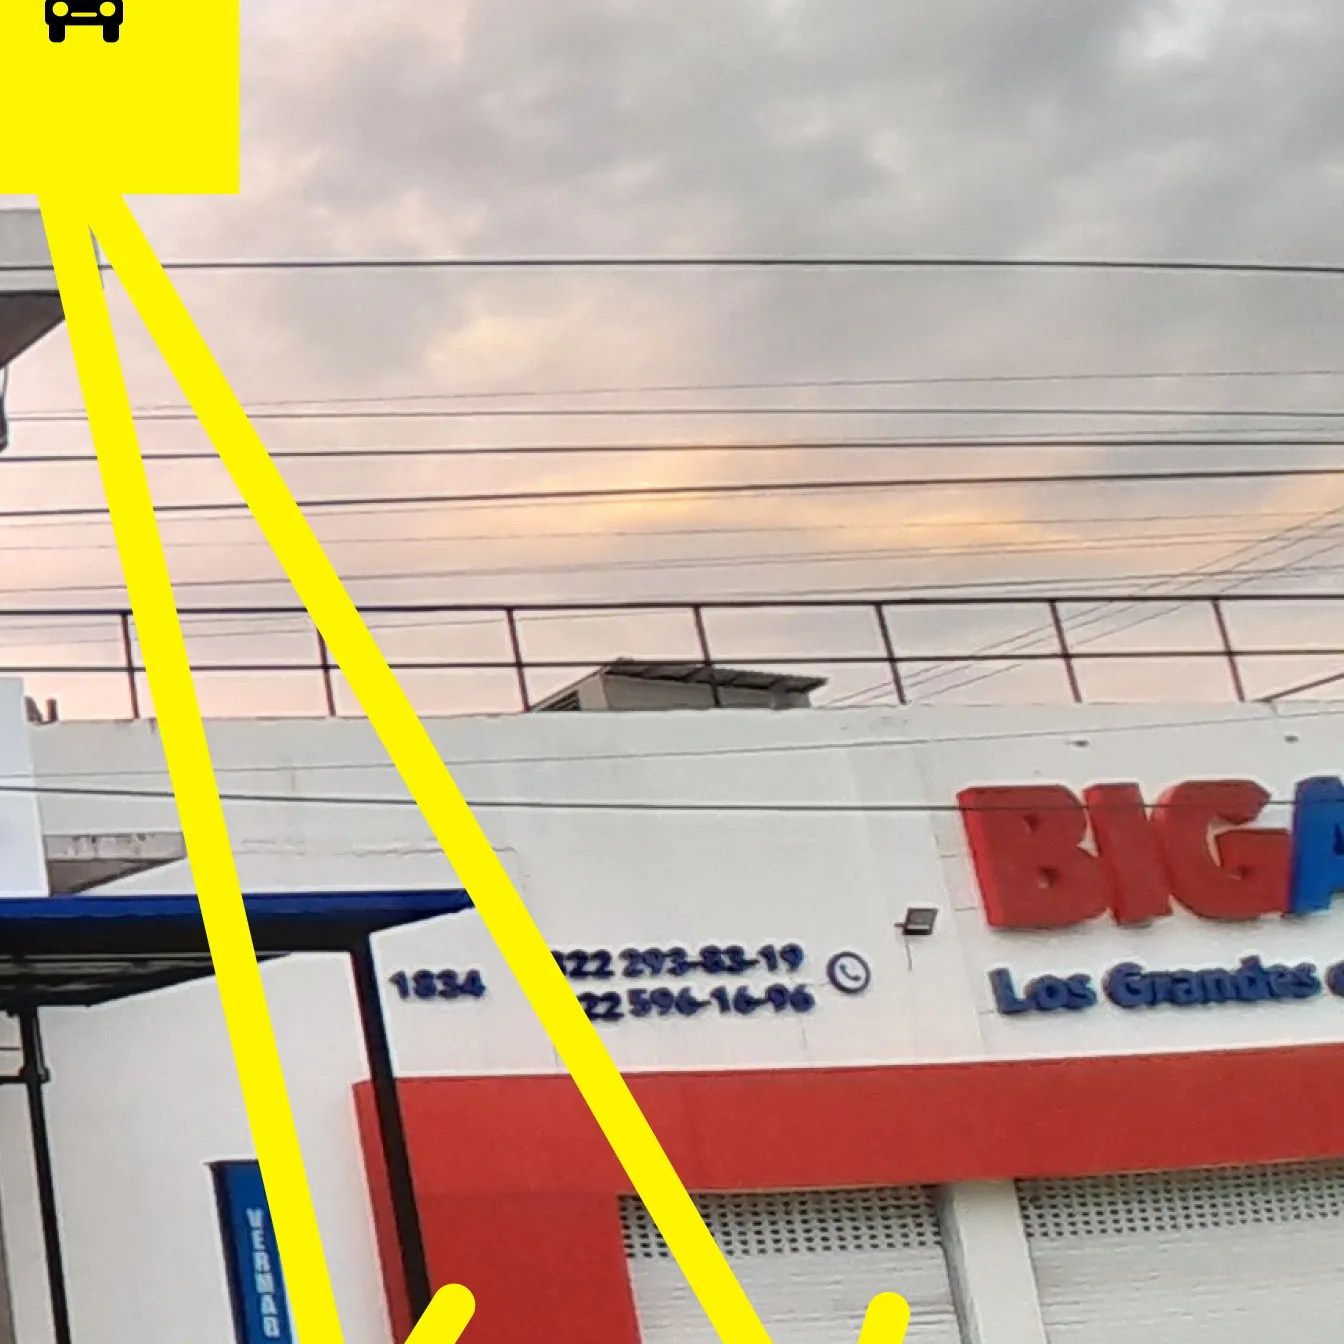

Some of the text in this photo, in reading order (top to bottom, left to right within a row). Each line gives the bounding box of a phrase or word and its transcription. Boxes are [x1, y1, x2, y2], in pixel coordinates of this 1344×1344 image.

[618, 942, 805, 979] 293-83-19
[387, 968, 487, 1001] 1834
[626, 983, 816, 1018] 596-16-96
[988, 967, 1097, 1015] Los
[1102, 955, 1322, 1009] Grandes
